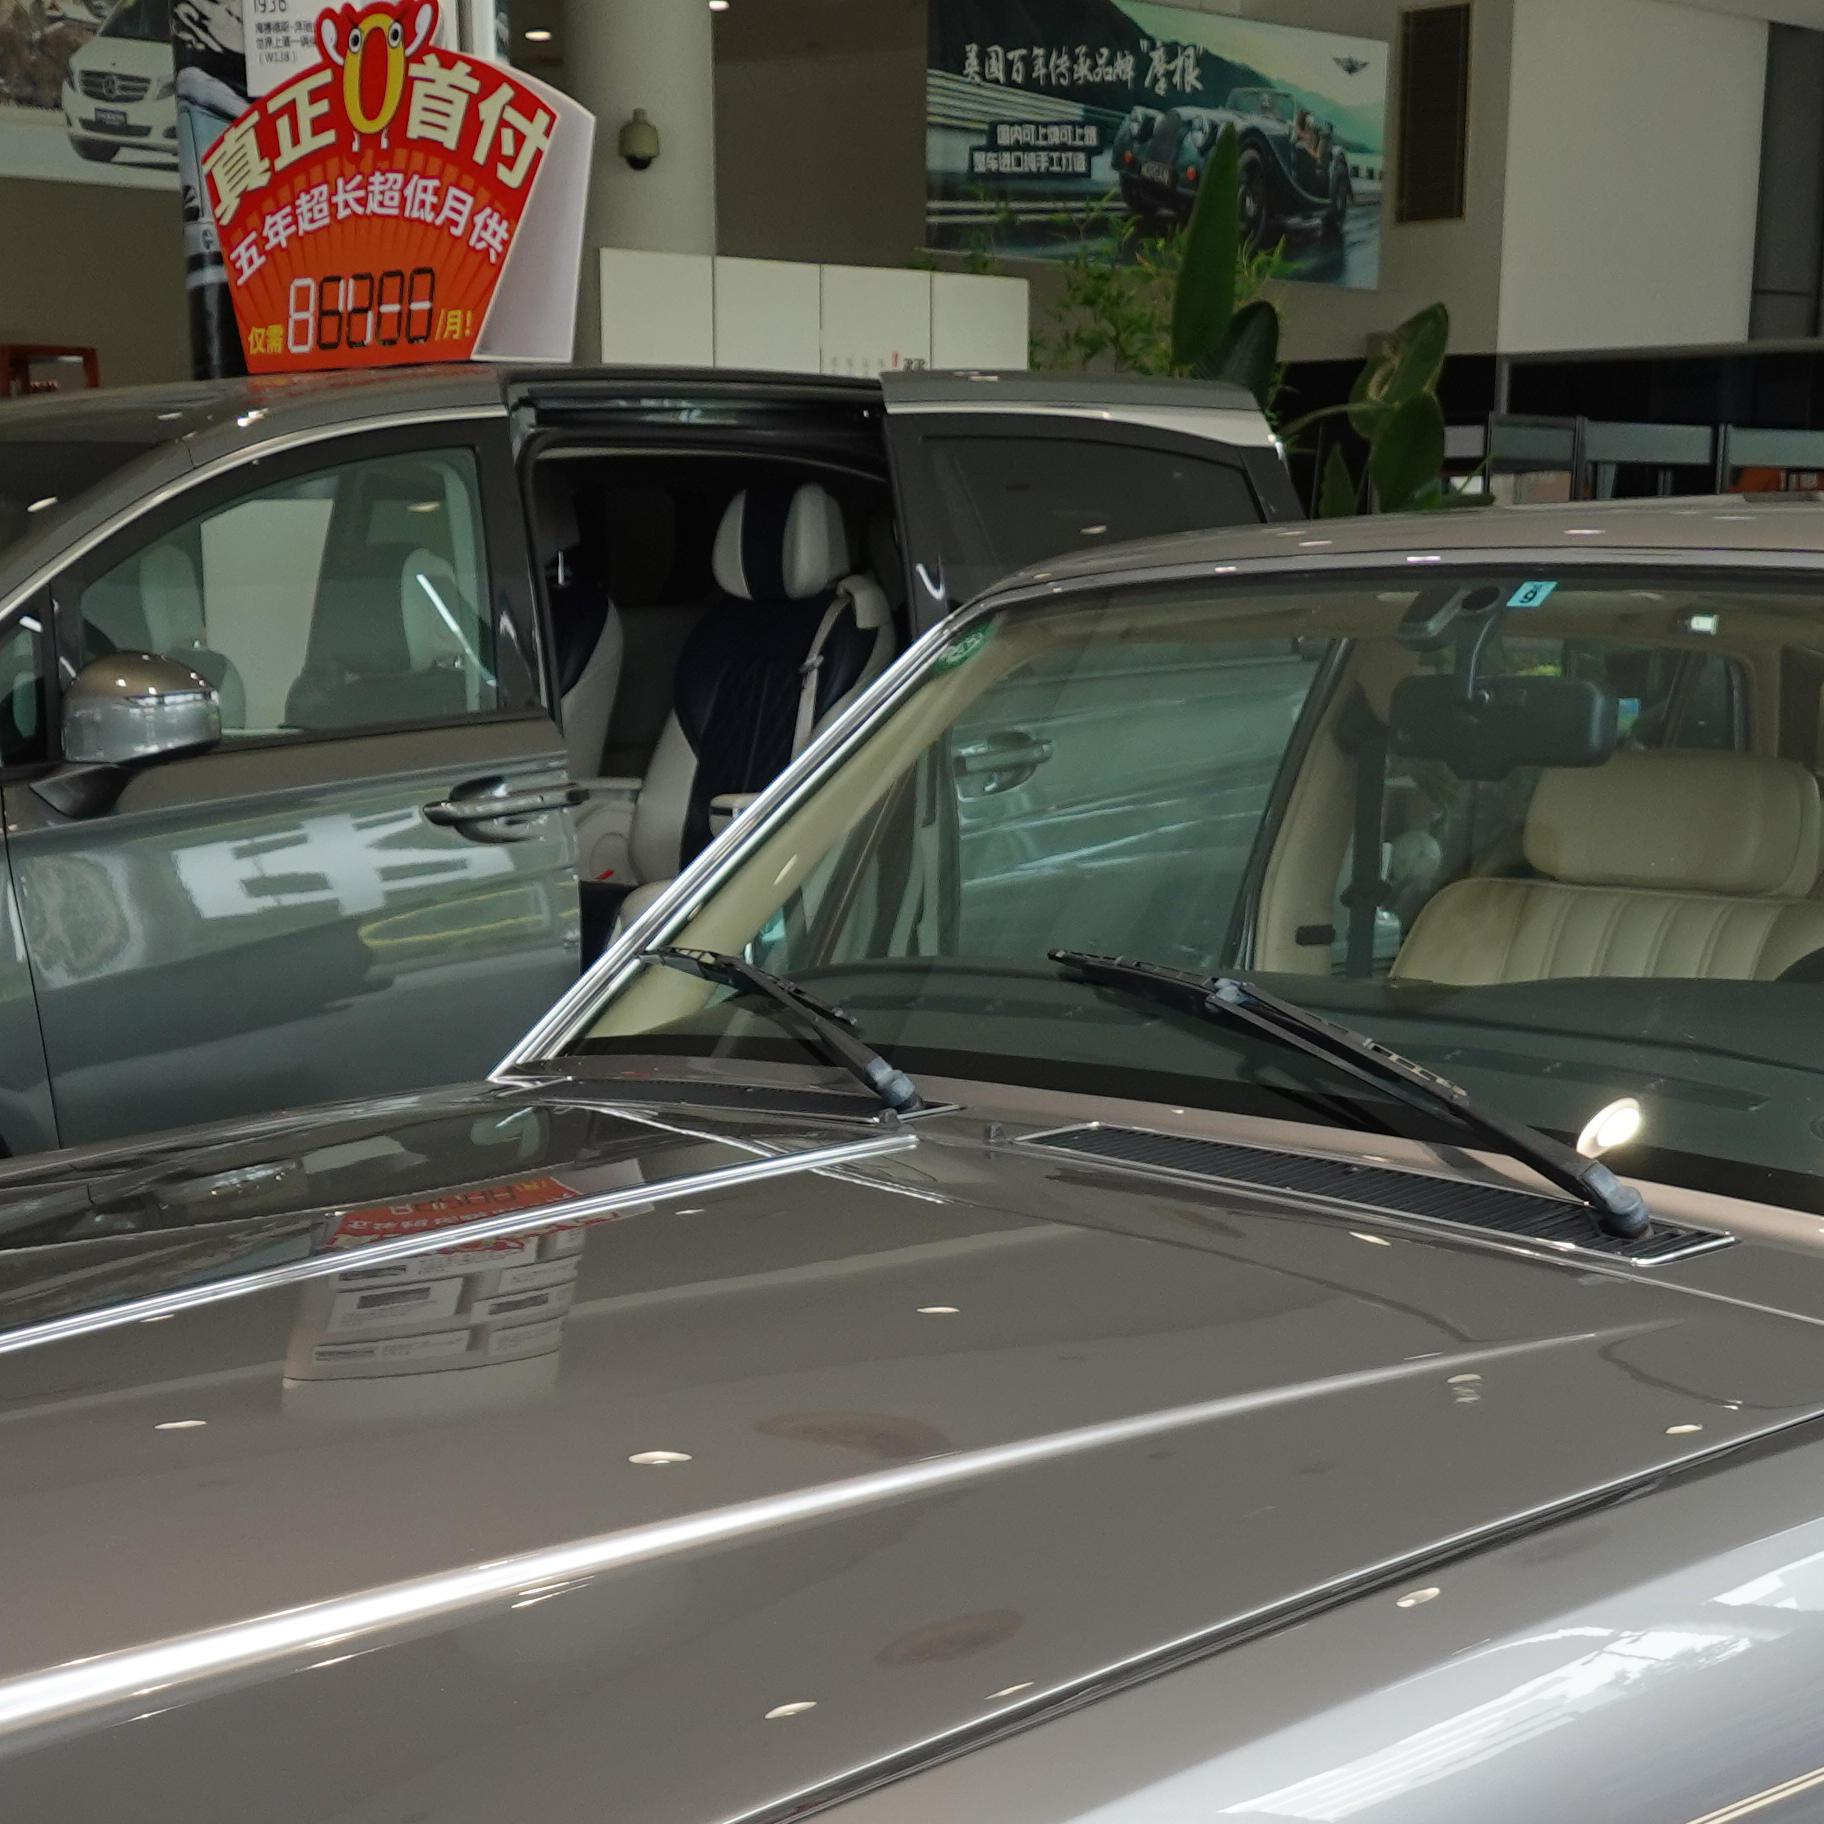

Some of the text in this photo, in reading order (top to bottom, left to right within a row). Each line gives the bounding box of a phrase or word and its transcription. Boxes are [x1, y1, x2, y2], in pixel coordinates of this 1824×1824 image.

[229, 170, 509, 288] 五年超长超低月供
